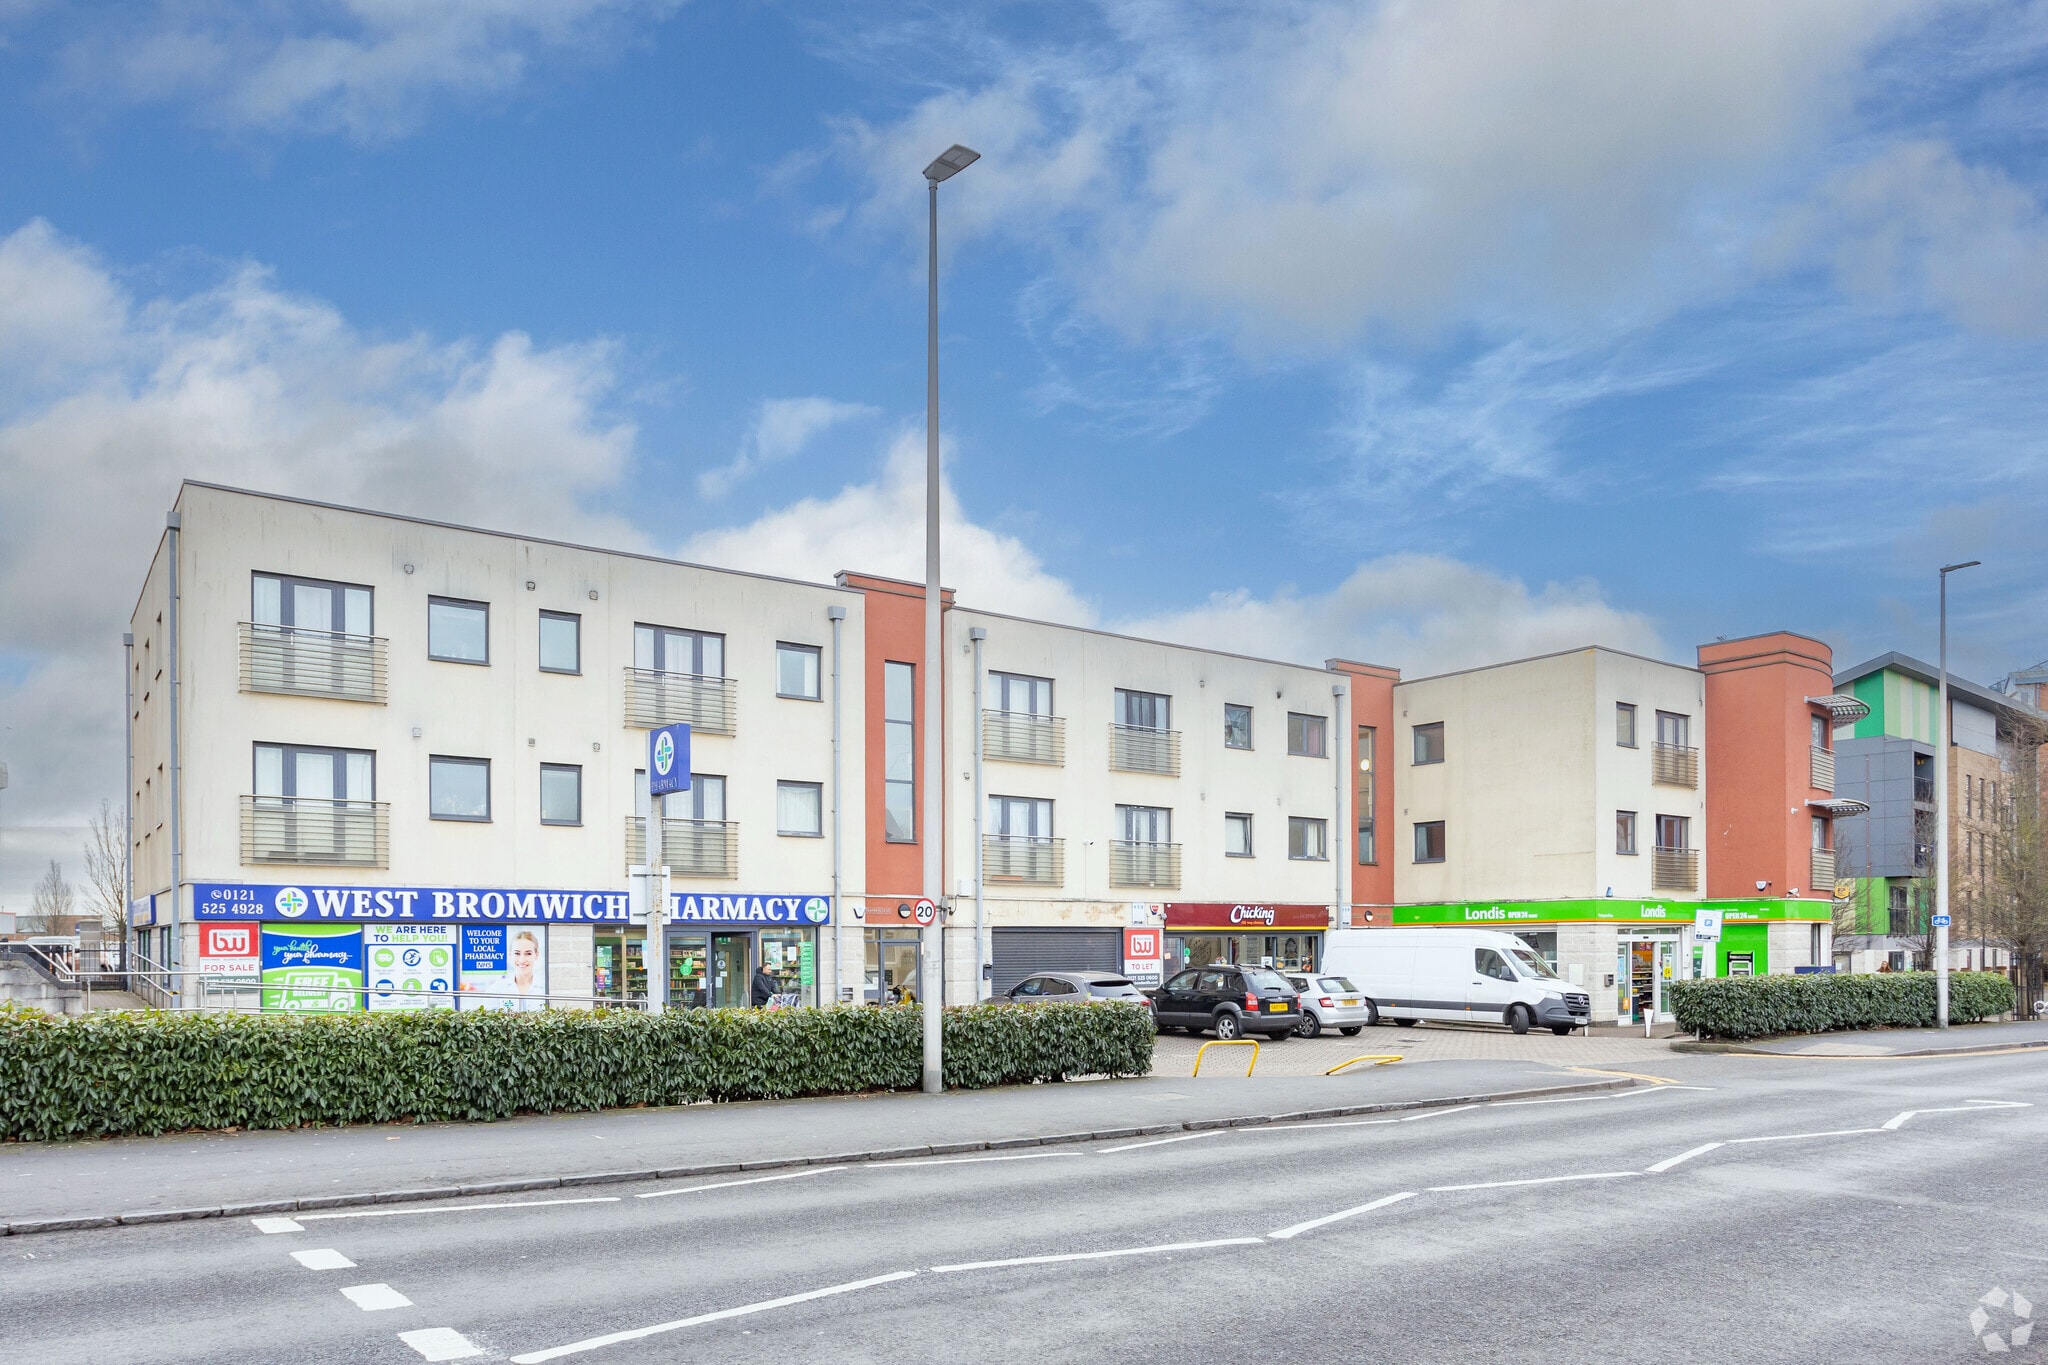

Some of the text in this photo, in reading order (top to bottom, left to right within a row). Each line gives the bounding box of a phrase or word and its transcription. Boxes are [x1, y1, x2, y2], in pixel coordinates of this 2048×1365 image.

[223, 889, 255, 900] 0121
[201, 903, 264, 915] 525 4928
[311, 889, 802, 921] WEST BROMWICH ARMACY
[1640, 904, 1666, 918] Londis
[917, 906, 933, 918] 20
[1465, 906, 1505, 920] Londis
[272, 945, 289, 956] your
[282, 952, 303, 964] your
[294, 976, 330, 986] FREE
